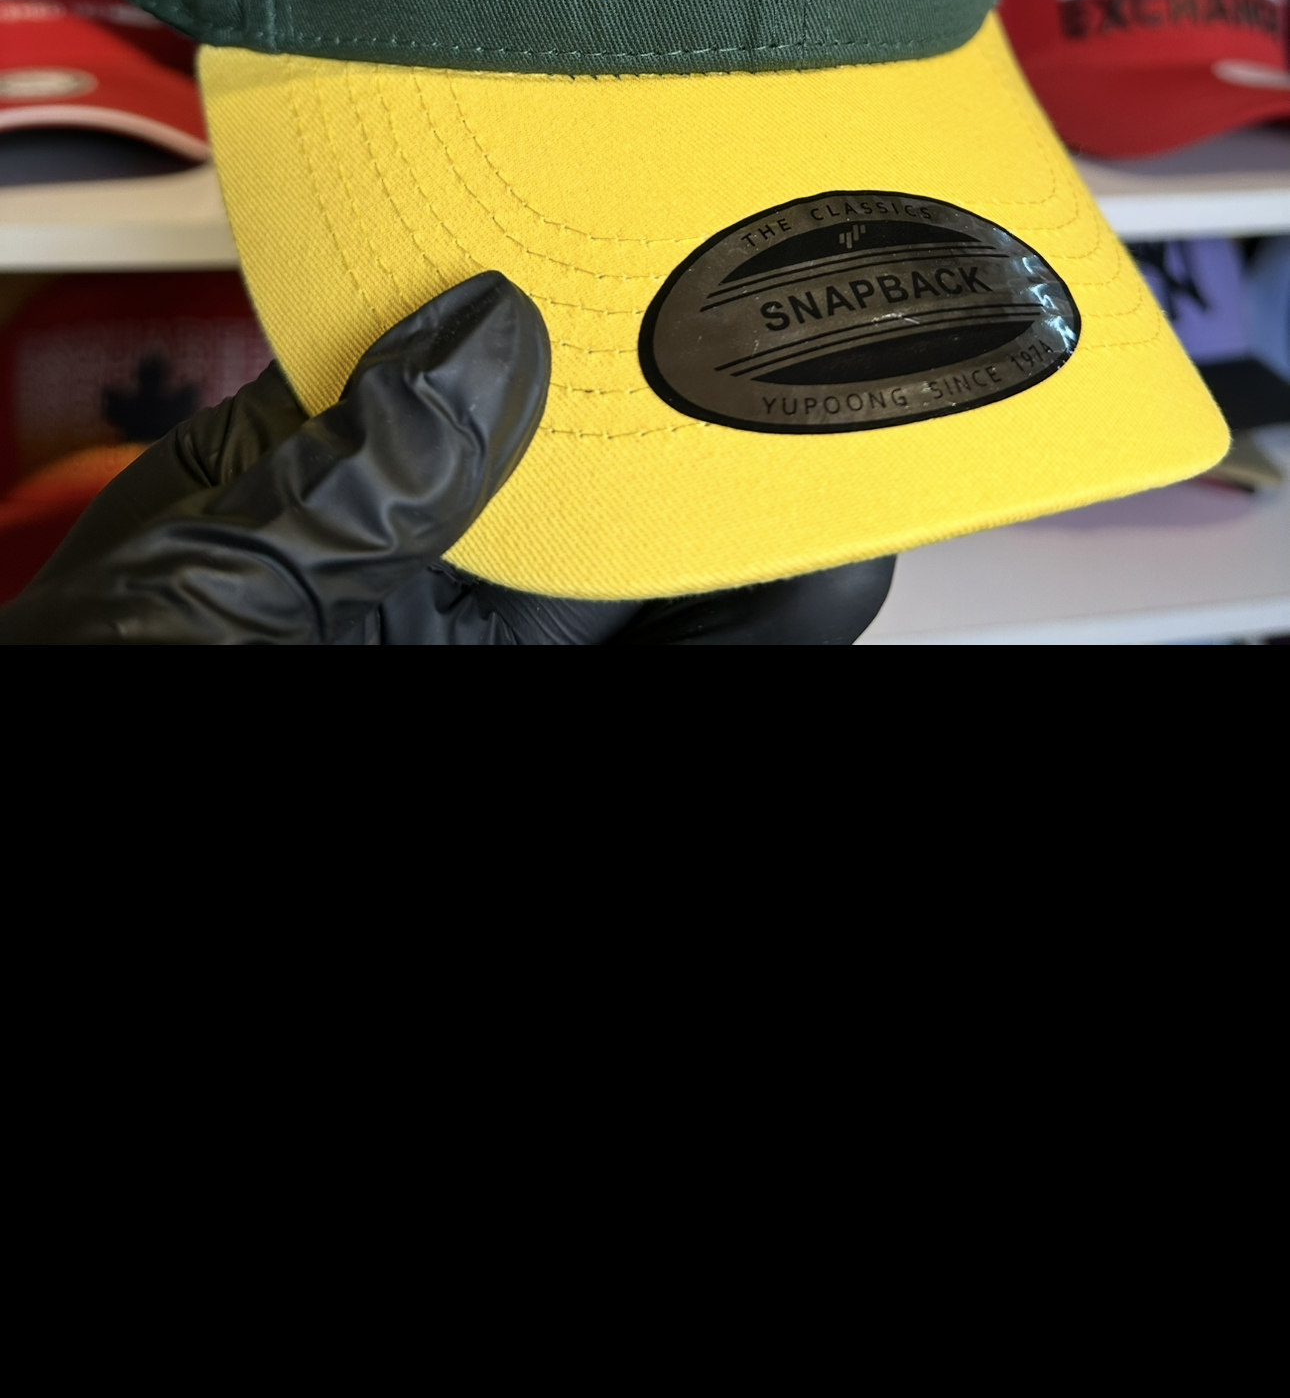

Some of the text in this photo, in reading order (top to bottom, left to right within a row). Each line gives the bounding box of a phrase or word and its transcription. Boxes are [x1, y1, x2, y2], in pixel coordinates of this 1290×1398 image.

[741, 202, 932, 248] THE CLASSICS
[760, 267, 993, 331] SNAPBACK
[762, 388, 908, 416] YUPOONG
[929, 364, 1003, 400] SINCE
